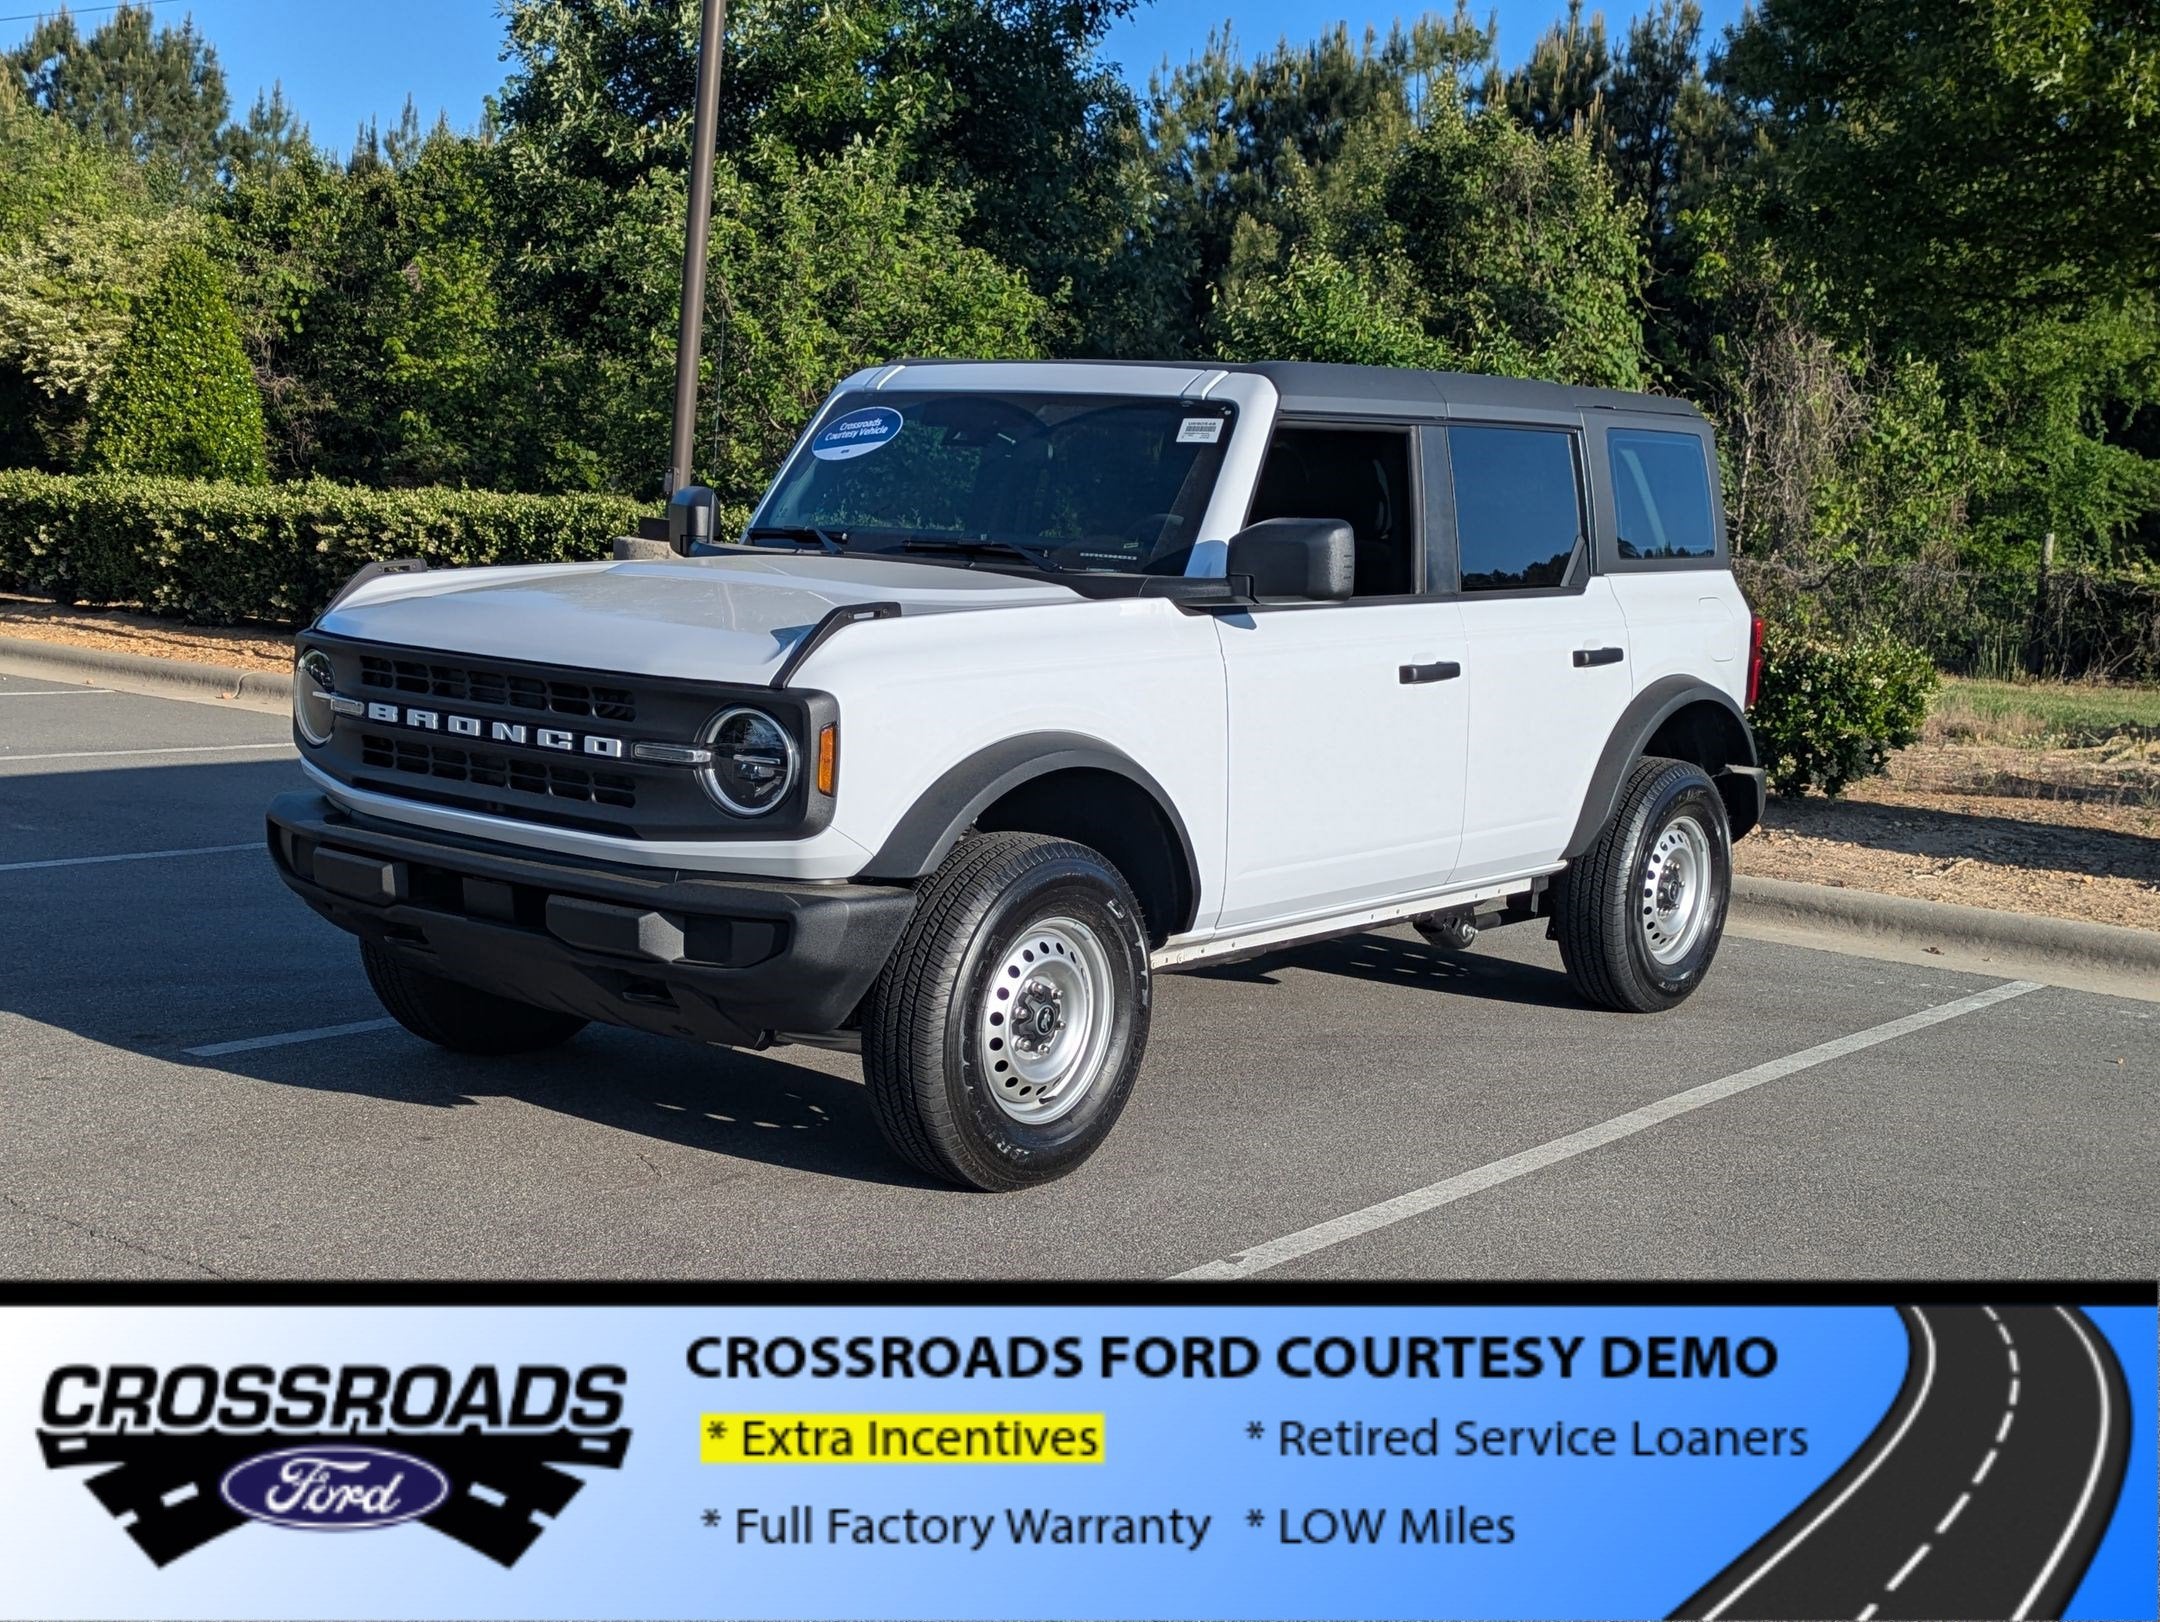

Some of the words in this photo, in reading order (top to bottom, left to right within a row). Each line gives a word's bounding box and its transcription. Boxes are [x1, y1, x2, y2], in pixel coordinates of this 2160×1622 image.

[840, 418, 882, 431] Crossroads
[825, 431, 859, 441] Courtesy
[859, 425, 888, 436] Vehicle
[368, 702, 622, 758] BRONCO
